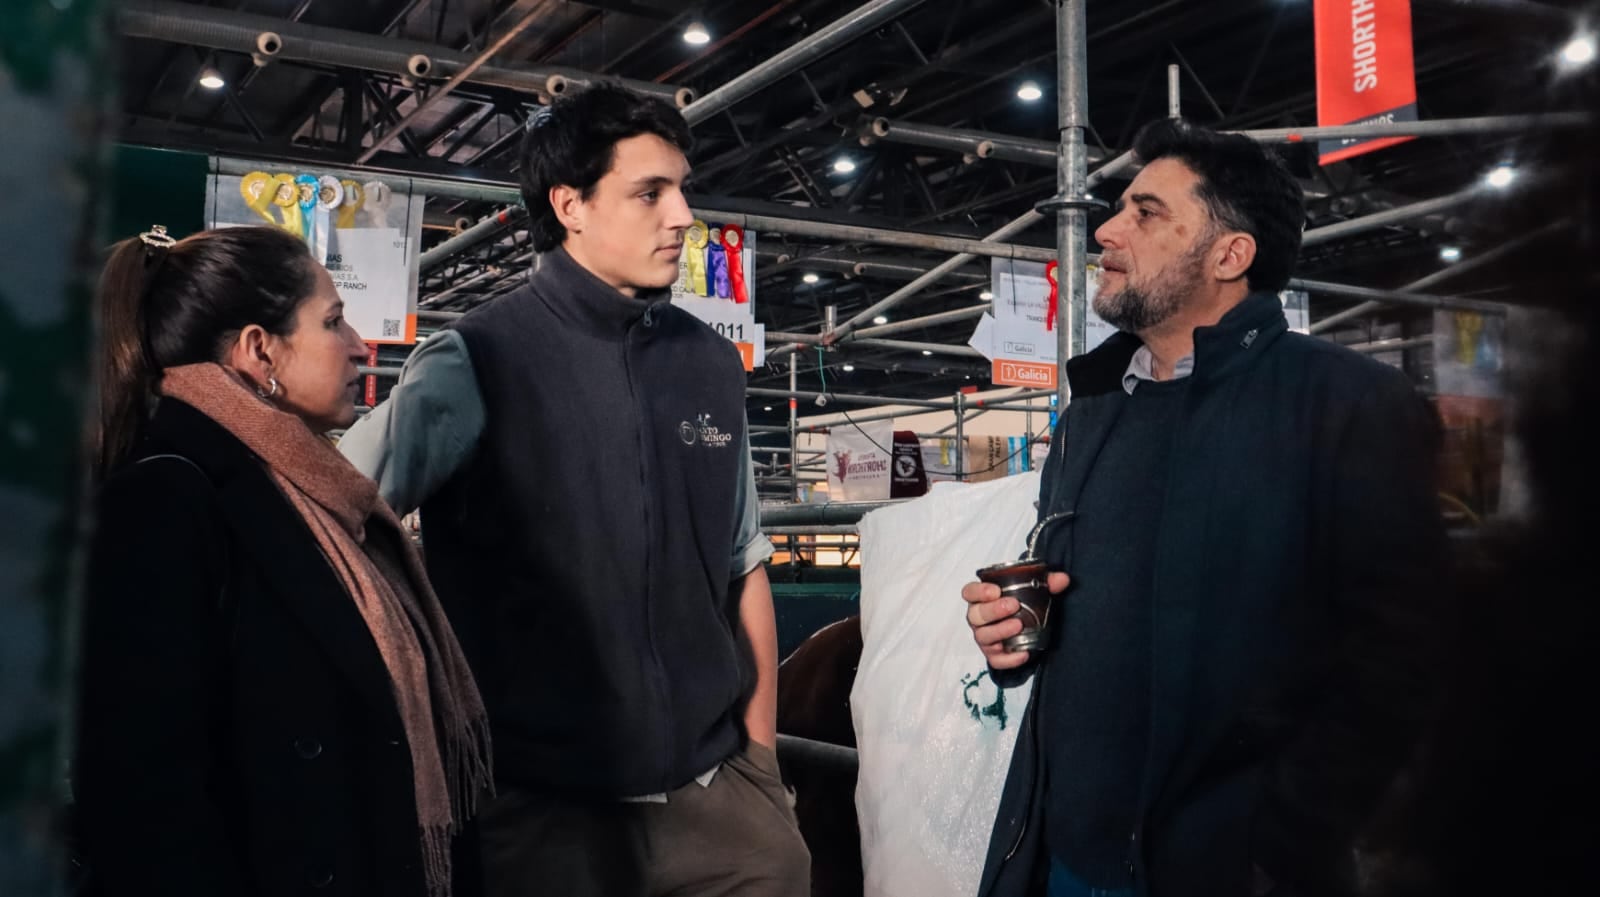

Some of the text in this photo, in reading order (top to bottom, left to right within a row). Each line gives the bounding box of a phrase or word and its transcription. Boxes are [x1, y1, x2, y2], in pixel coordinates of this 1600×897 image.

[1351, 0, 1378, 93] SHORTH
[343, 282, 368, 291] RANCH
[709, 322, 743, 340] 011
[1014, 344, 1033, 353] Galicia
[1017, 368, 1048, 381] Galicia
